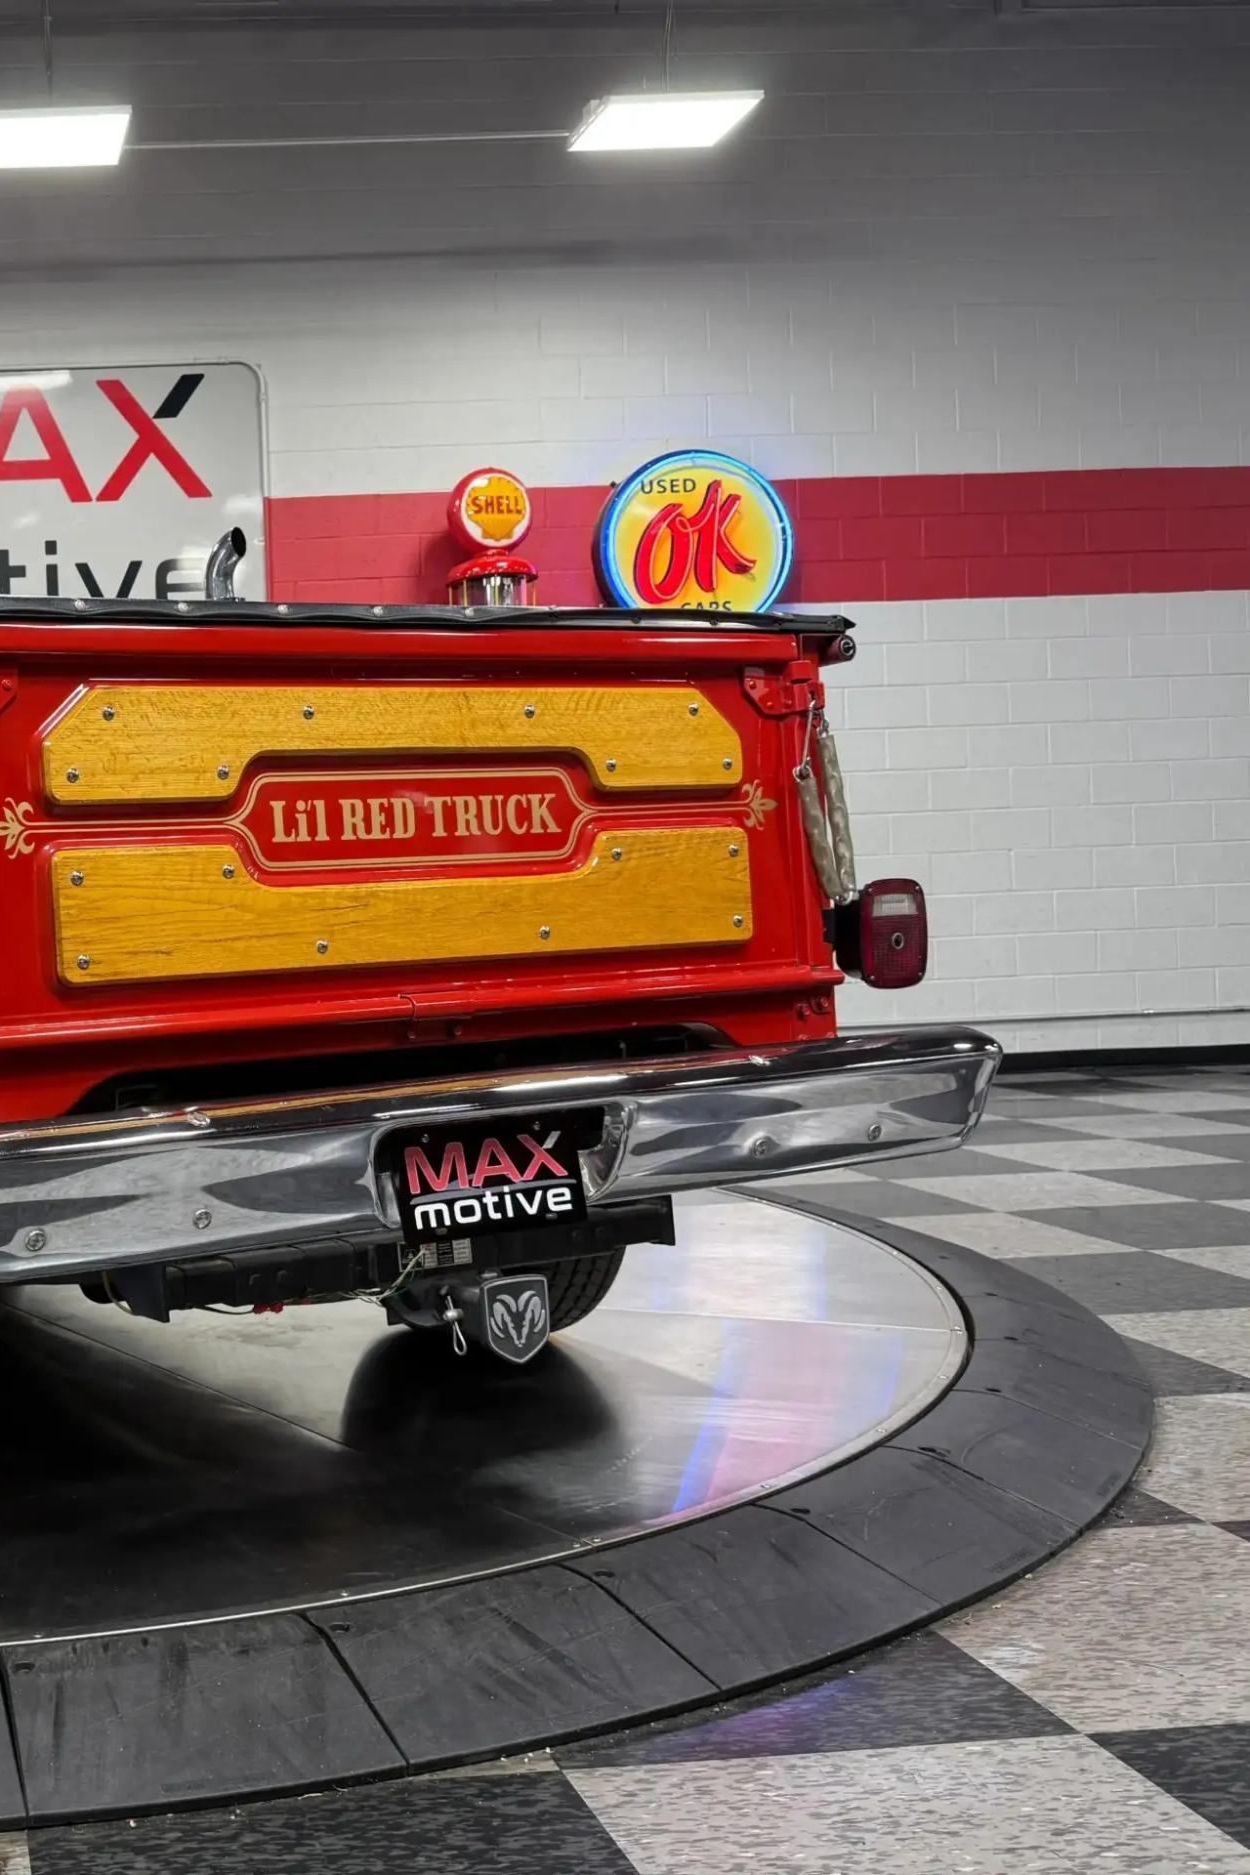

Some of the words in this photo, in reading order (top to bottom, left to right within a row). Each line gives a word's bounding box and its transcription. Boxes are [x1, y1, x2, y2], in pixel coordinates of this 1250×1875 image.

[471, 495, 523, 515] SHELL
[640, 478, 697, 495] USED
[633, 480, 757, 605] OK
[269, 800, 330, 843] Li'l
[338, 795, 416, 840] RED
[424, 793, 562, 837] TRUCK
[404, 1131, 568, 1195] MAX
[414, 1186, 573, 1230] motive
